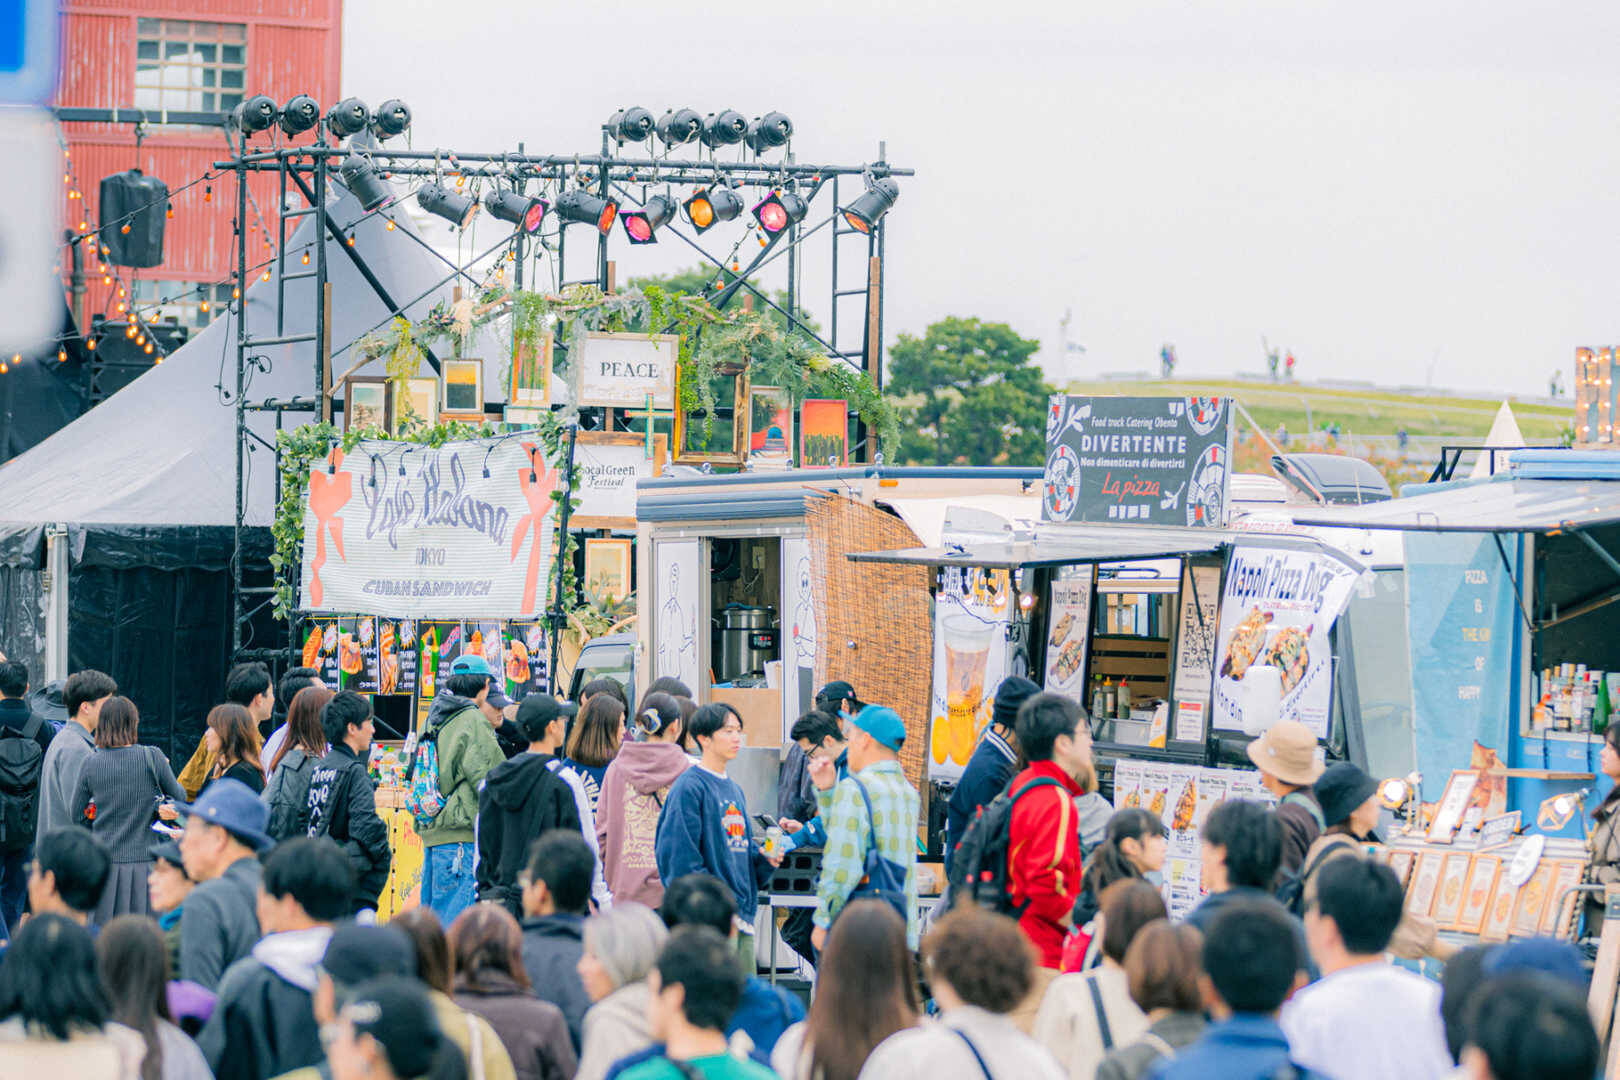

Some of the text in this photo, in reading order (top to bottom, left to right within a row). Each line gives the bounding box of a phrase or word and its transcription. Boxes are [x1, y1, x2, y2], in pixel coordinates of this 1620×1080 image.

[600, 361, 659, 378] PEACE
[1091, 416, 1178, 430] Food truck Catering Obento
[1081, 434, 1187, 454] DIVERTENTE
[585, 464, 635, 476] ocal Green
[1080, 456, 1185, 469] Non dimenticare di divertirti
[588, 475, 625, 488] Festival
[1102, 471, 1160, 503] La pizza
[362, 579, 491, 596] CUBAN SANDWICH
[1228, 555, 1335, 614] Napoli Pizza Dog
